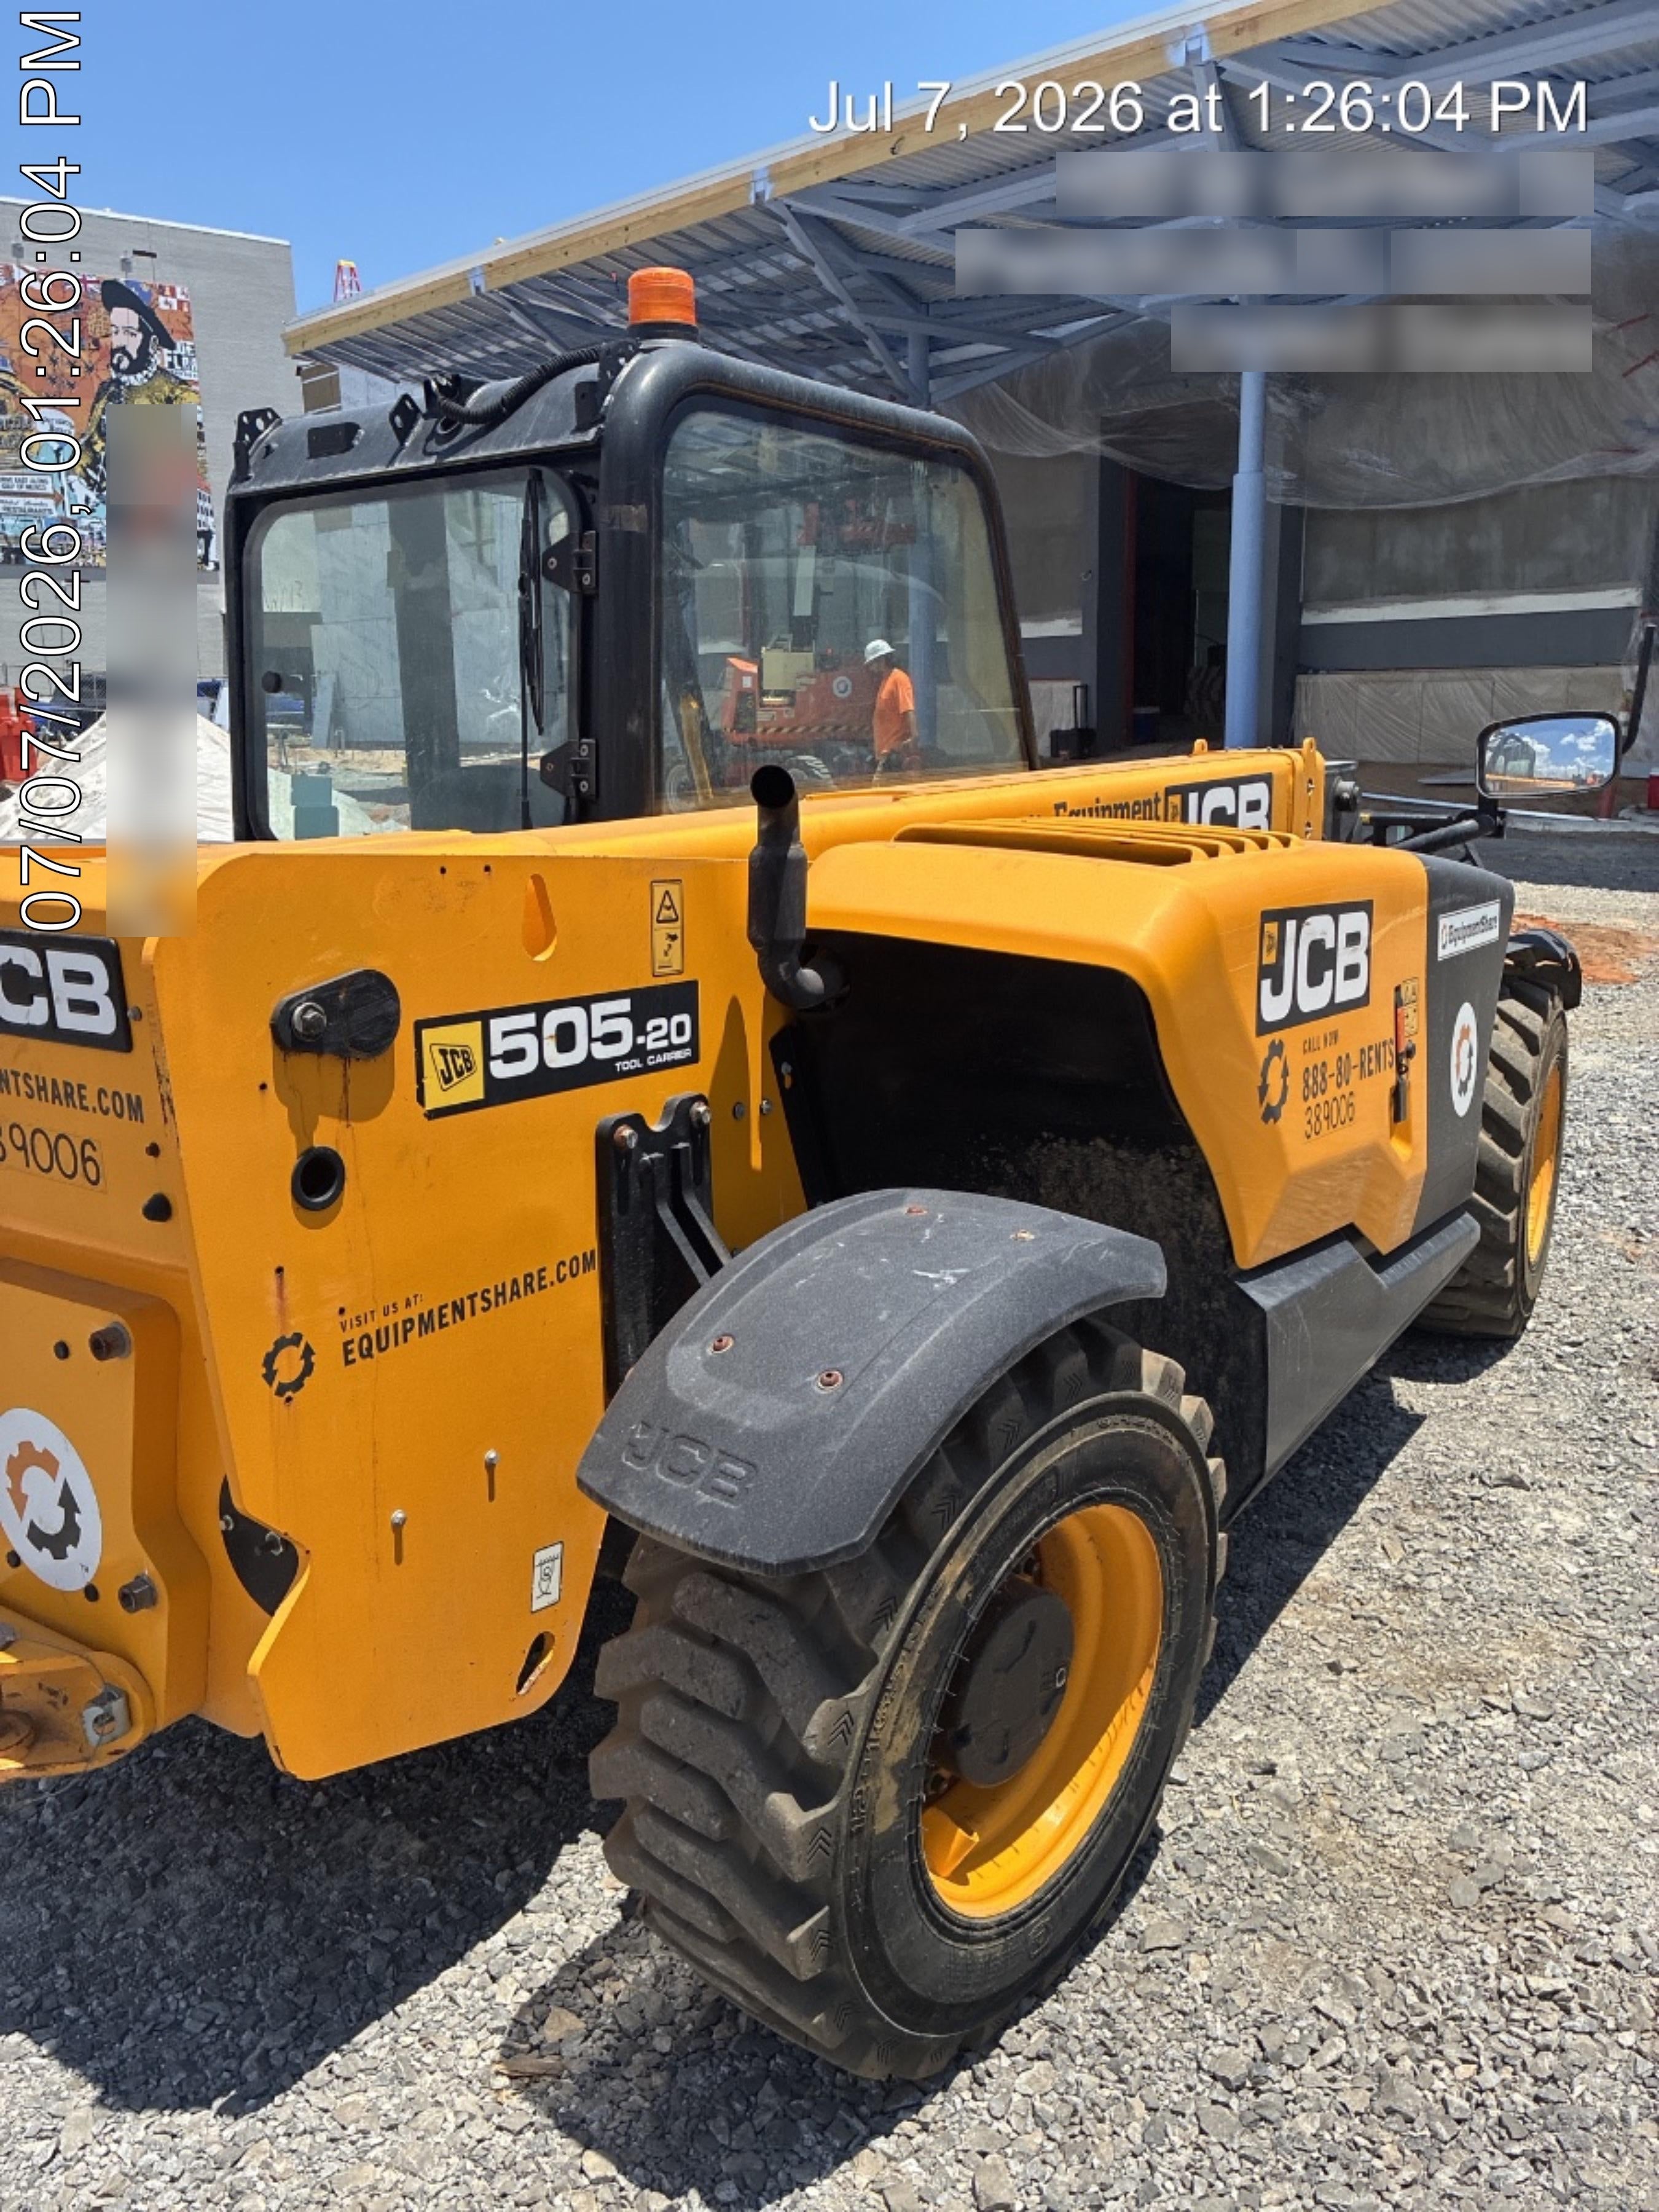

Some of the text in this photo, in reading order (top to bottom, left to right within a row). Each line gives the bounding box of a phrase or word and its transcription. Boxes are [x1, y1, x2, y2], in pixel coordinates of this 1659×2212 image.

[1260, 911, 1370, 1022] JCB
[437, 1047, 474, 1086] JCB
[489, 998, 692, 1079] 505-20
[615, 1048, 692, 1073] TOOL CARRIER
[1303, 1029, 1338, 1054] CALL NOW
[1302, 1037, 1395, 1103] 888-80-RENTS
[1304, 1091, 1355, 1140] 389006
[340, 1293, 423, 1333] VISIT US AT:
[342, 1248, 597, 1367] EQUIPMENTSHARE.COM
[621, 1420, 758, 1509] JCB
